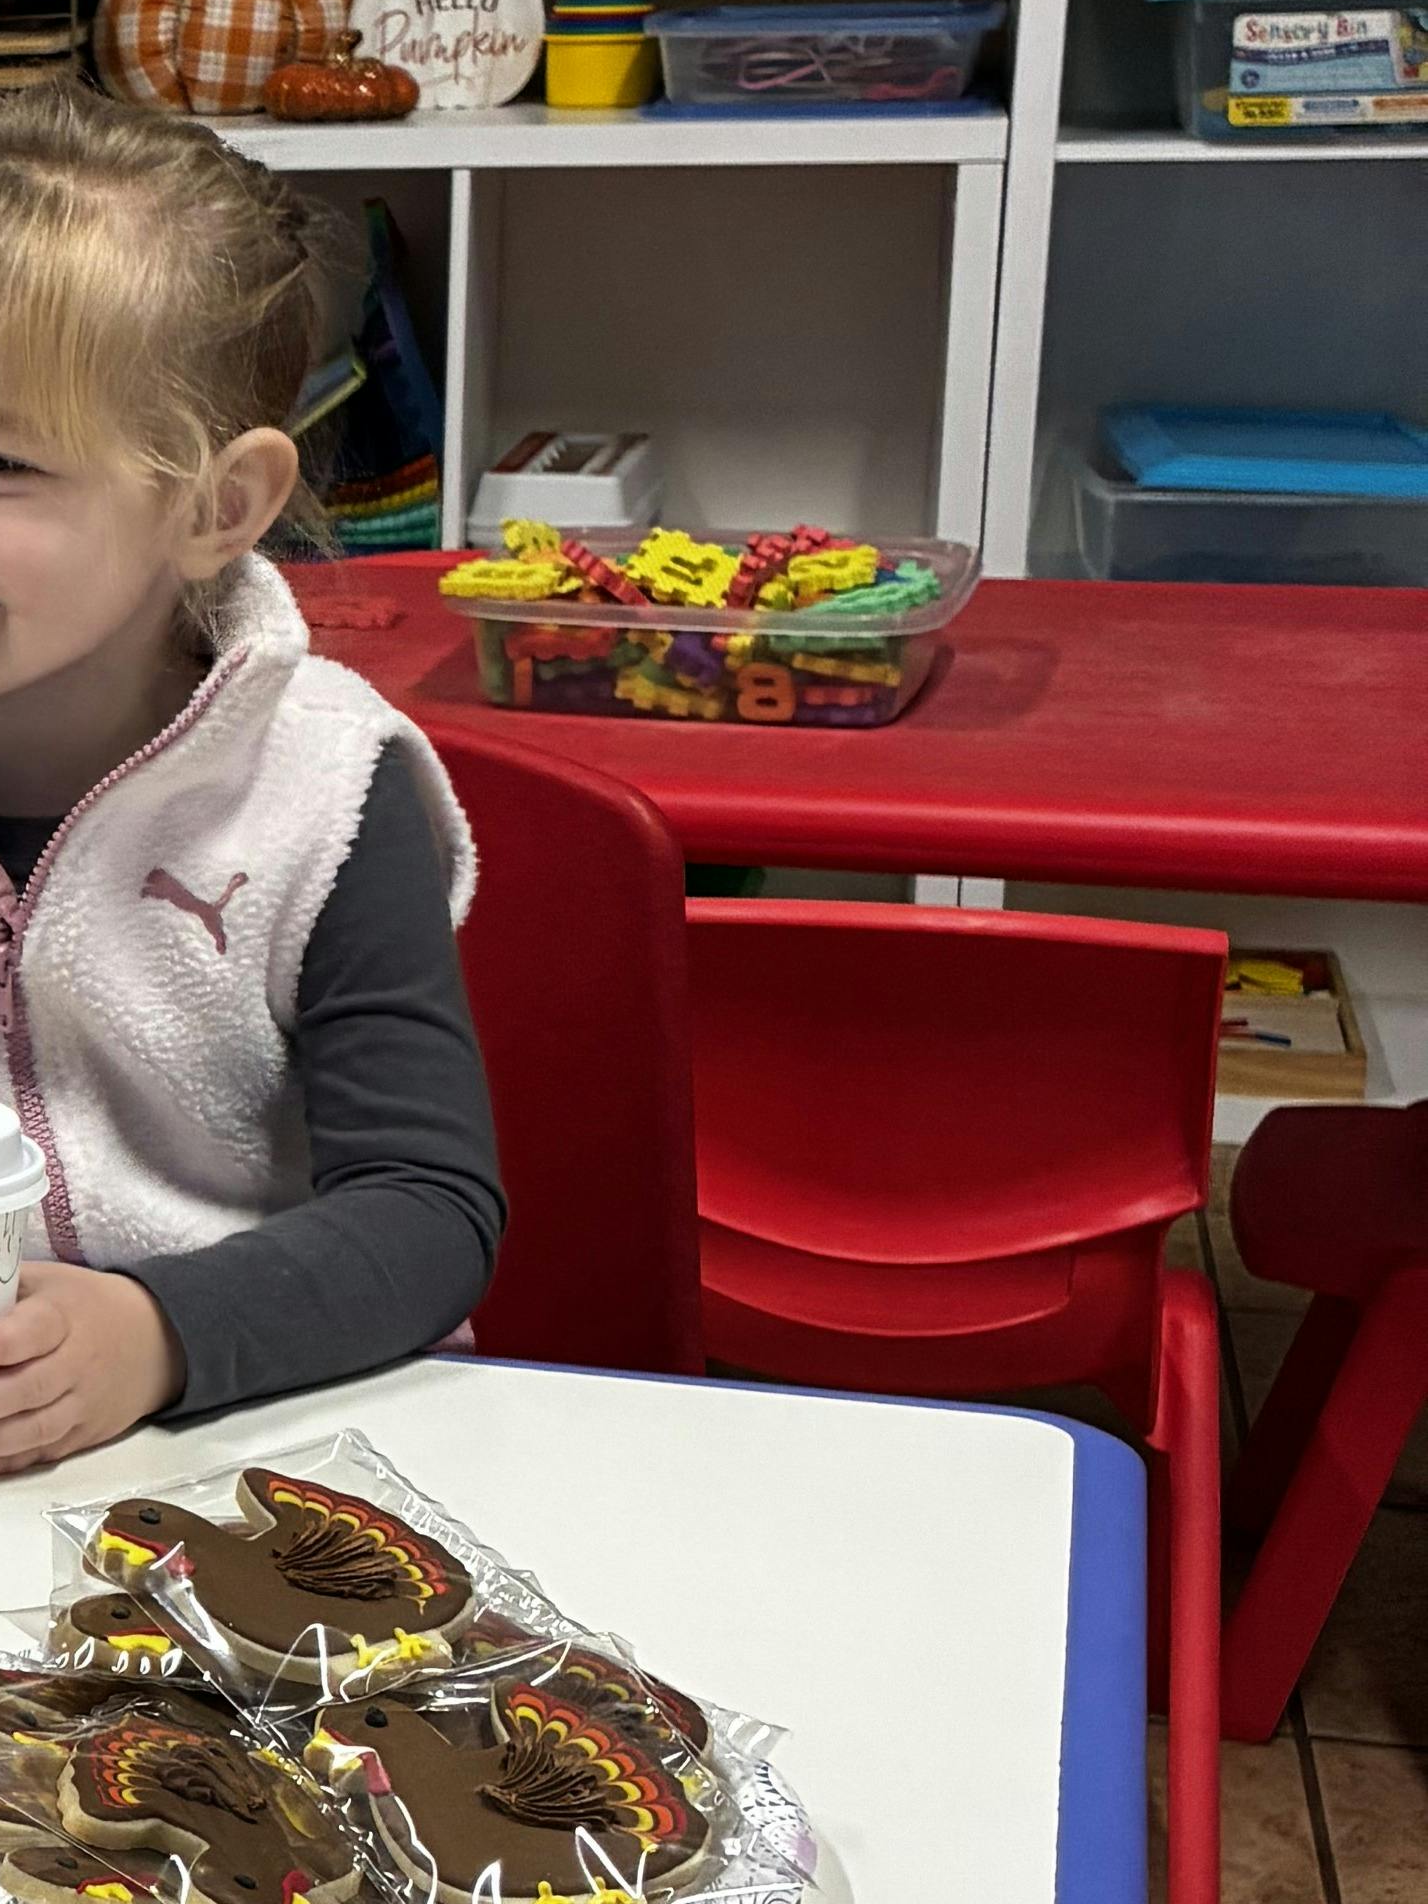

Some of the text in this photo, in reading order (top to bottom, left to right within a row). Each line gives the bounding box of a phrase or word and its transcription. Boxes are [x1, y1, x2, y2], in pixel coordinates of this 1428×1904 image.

[374, 7, 530, 87] Pumpkin
[1245, 18, 1330, 46] Sensory
[737, 662, 798, 723] 8
